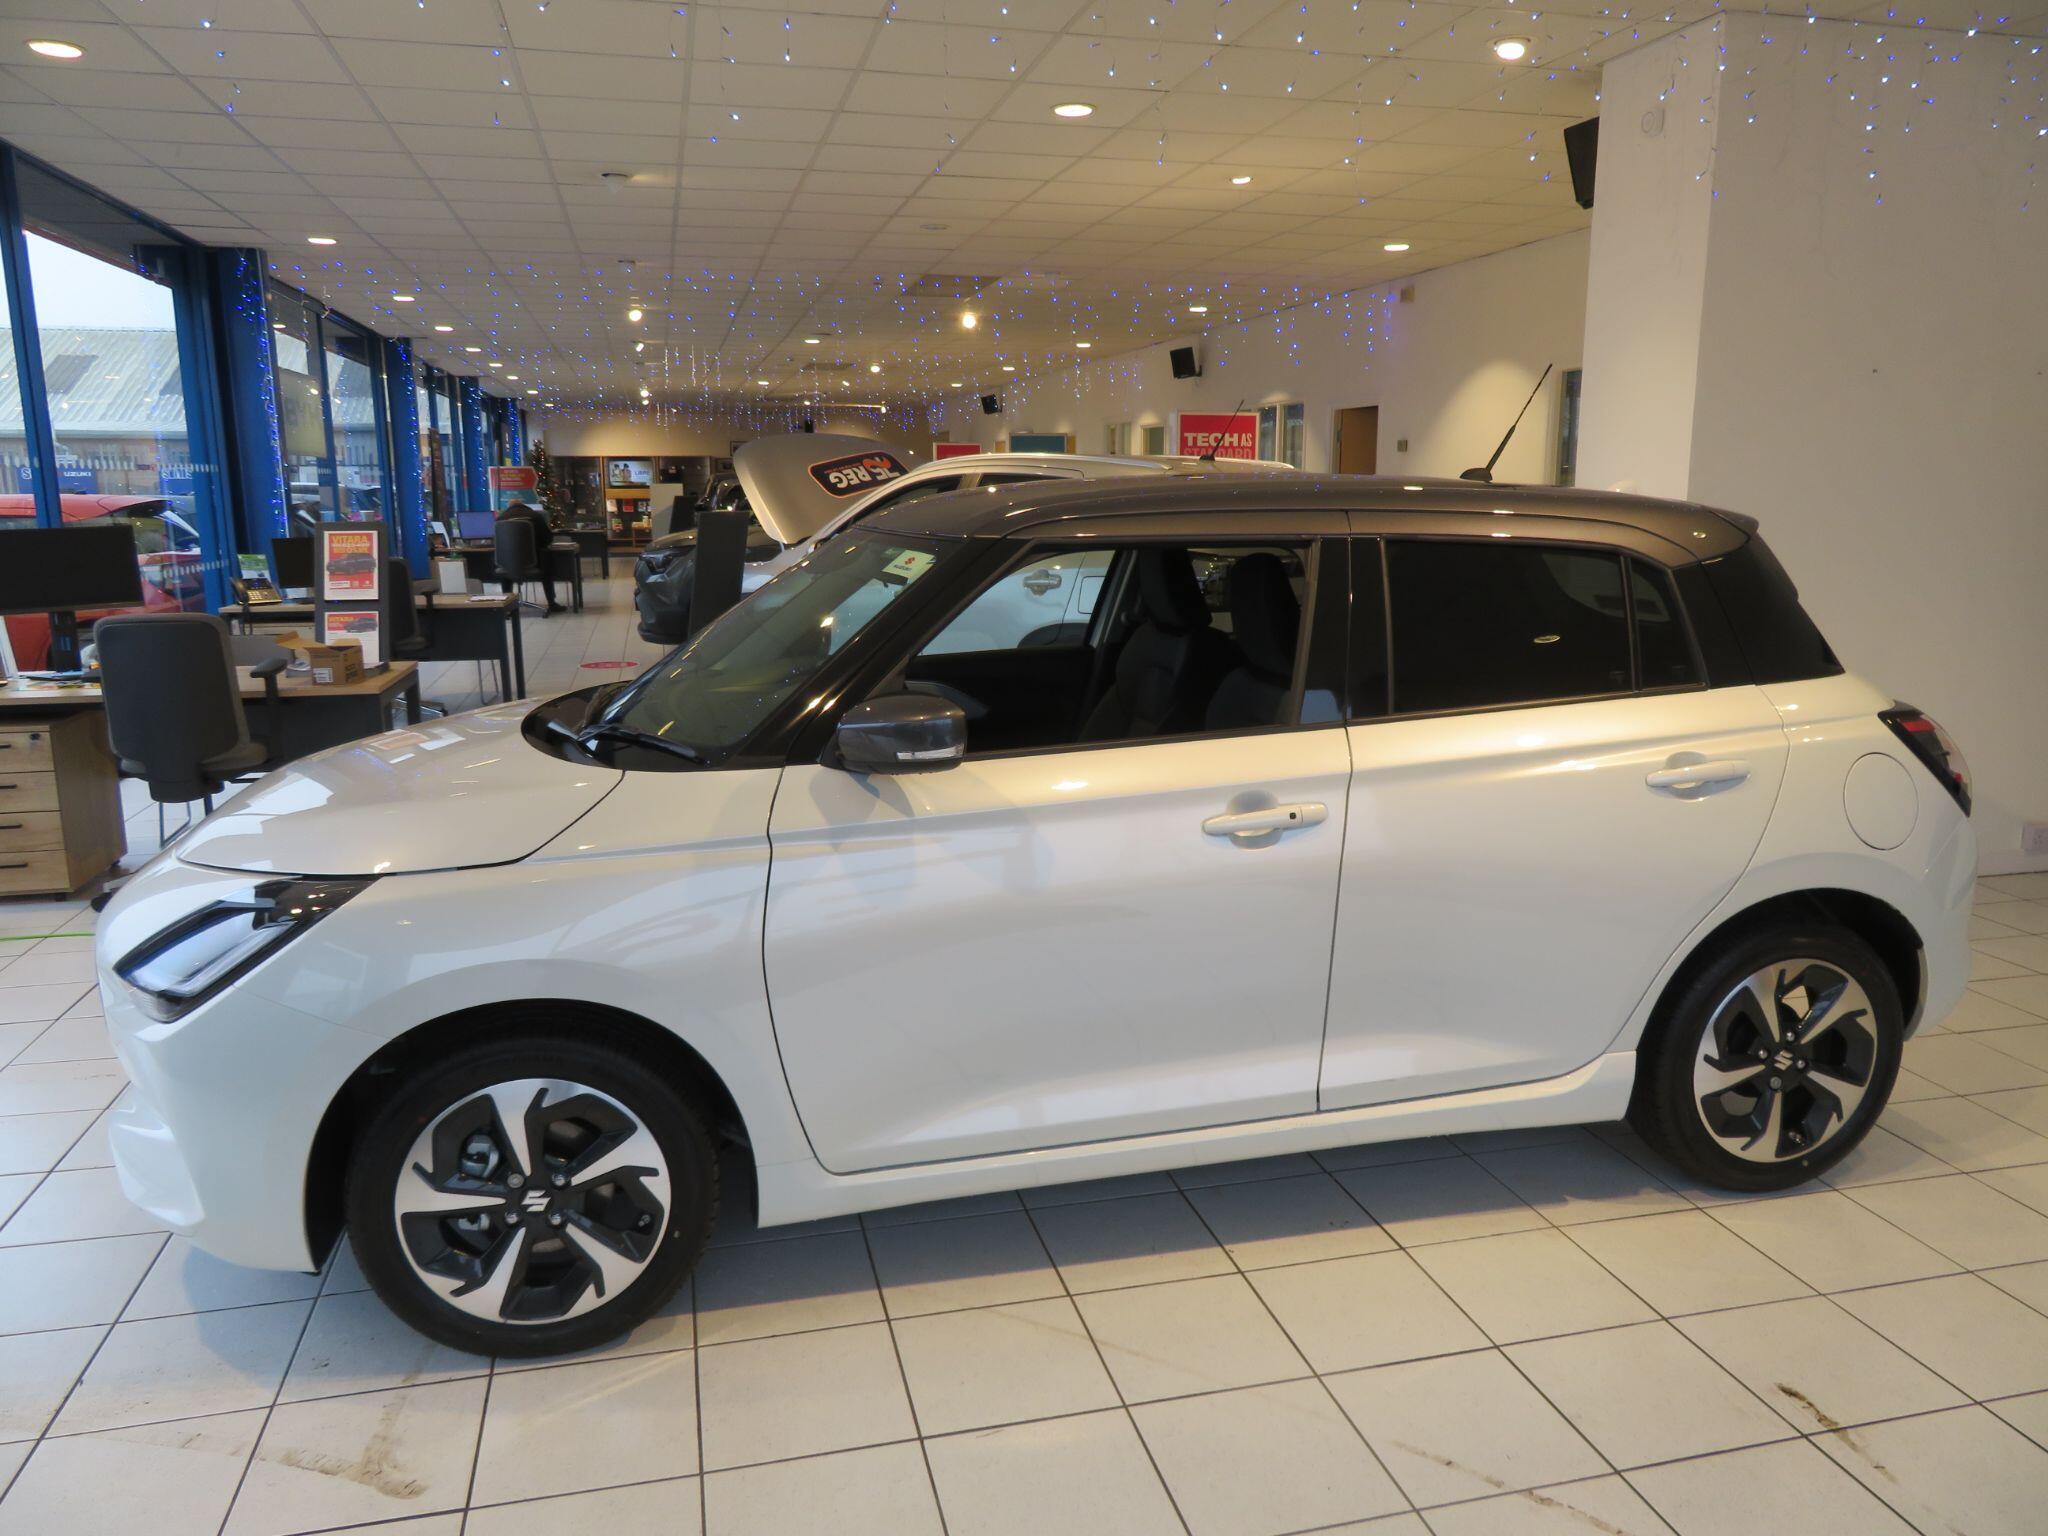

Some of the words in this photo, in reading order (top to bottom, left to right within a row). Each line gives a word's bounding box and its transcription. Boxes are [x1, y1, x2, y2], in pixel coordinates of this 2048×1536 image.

[1184, 432, 1238, 447] TECH
[1240, 432, 1252, 447] AS
[829, 465, 872, 488] REG
